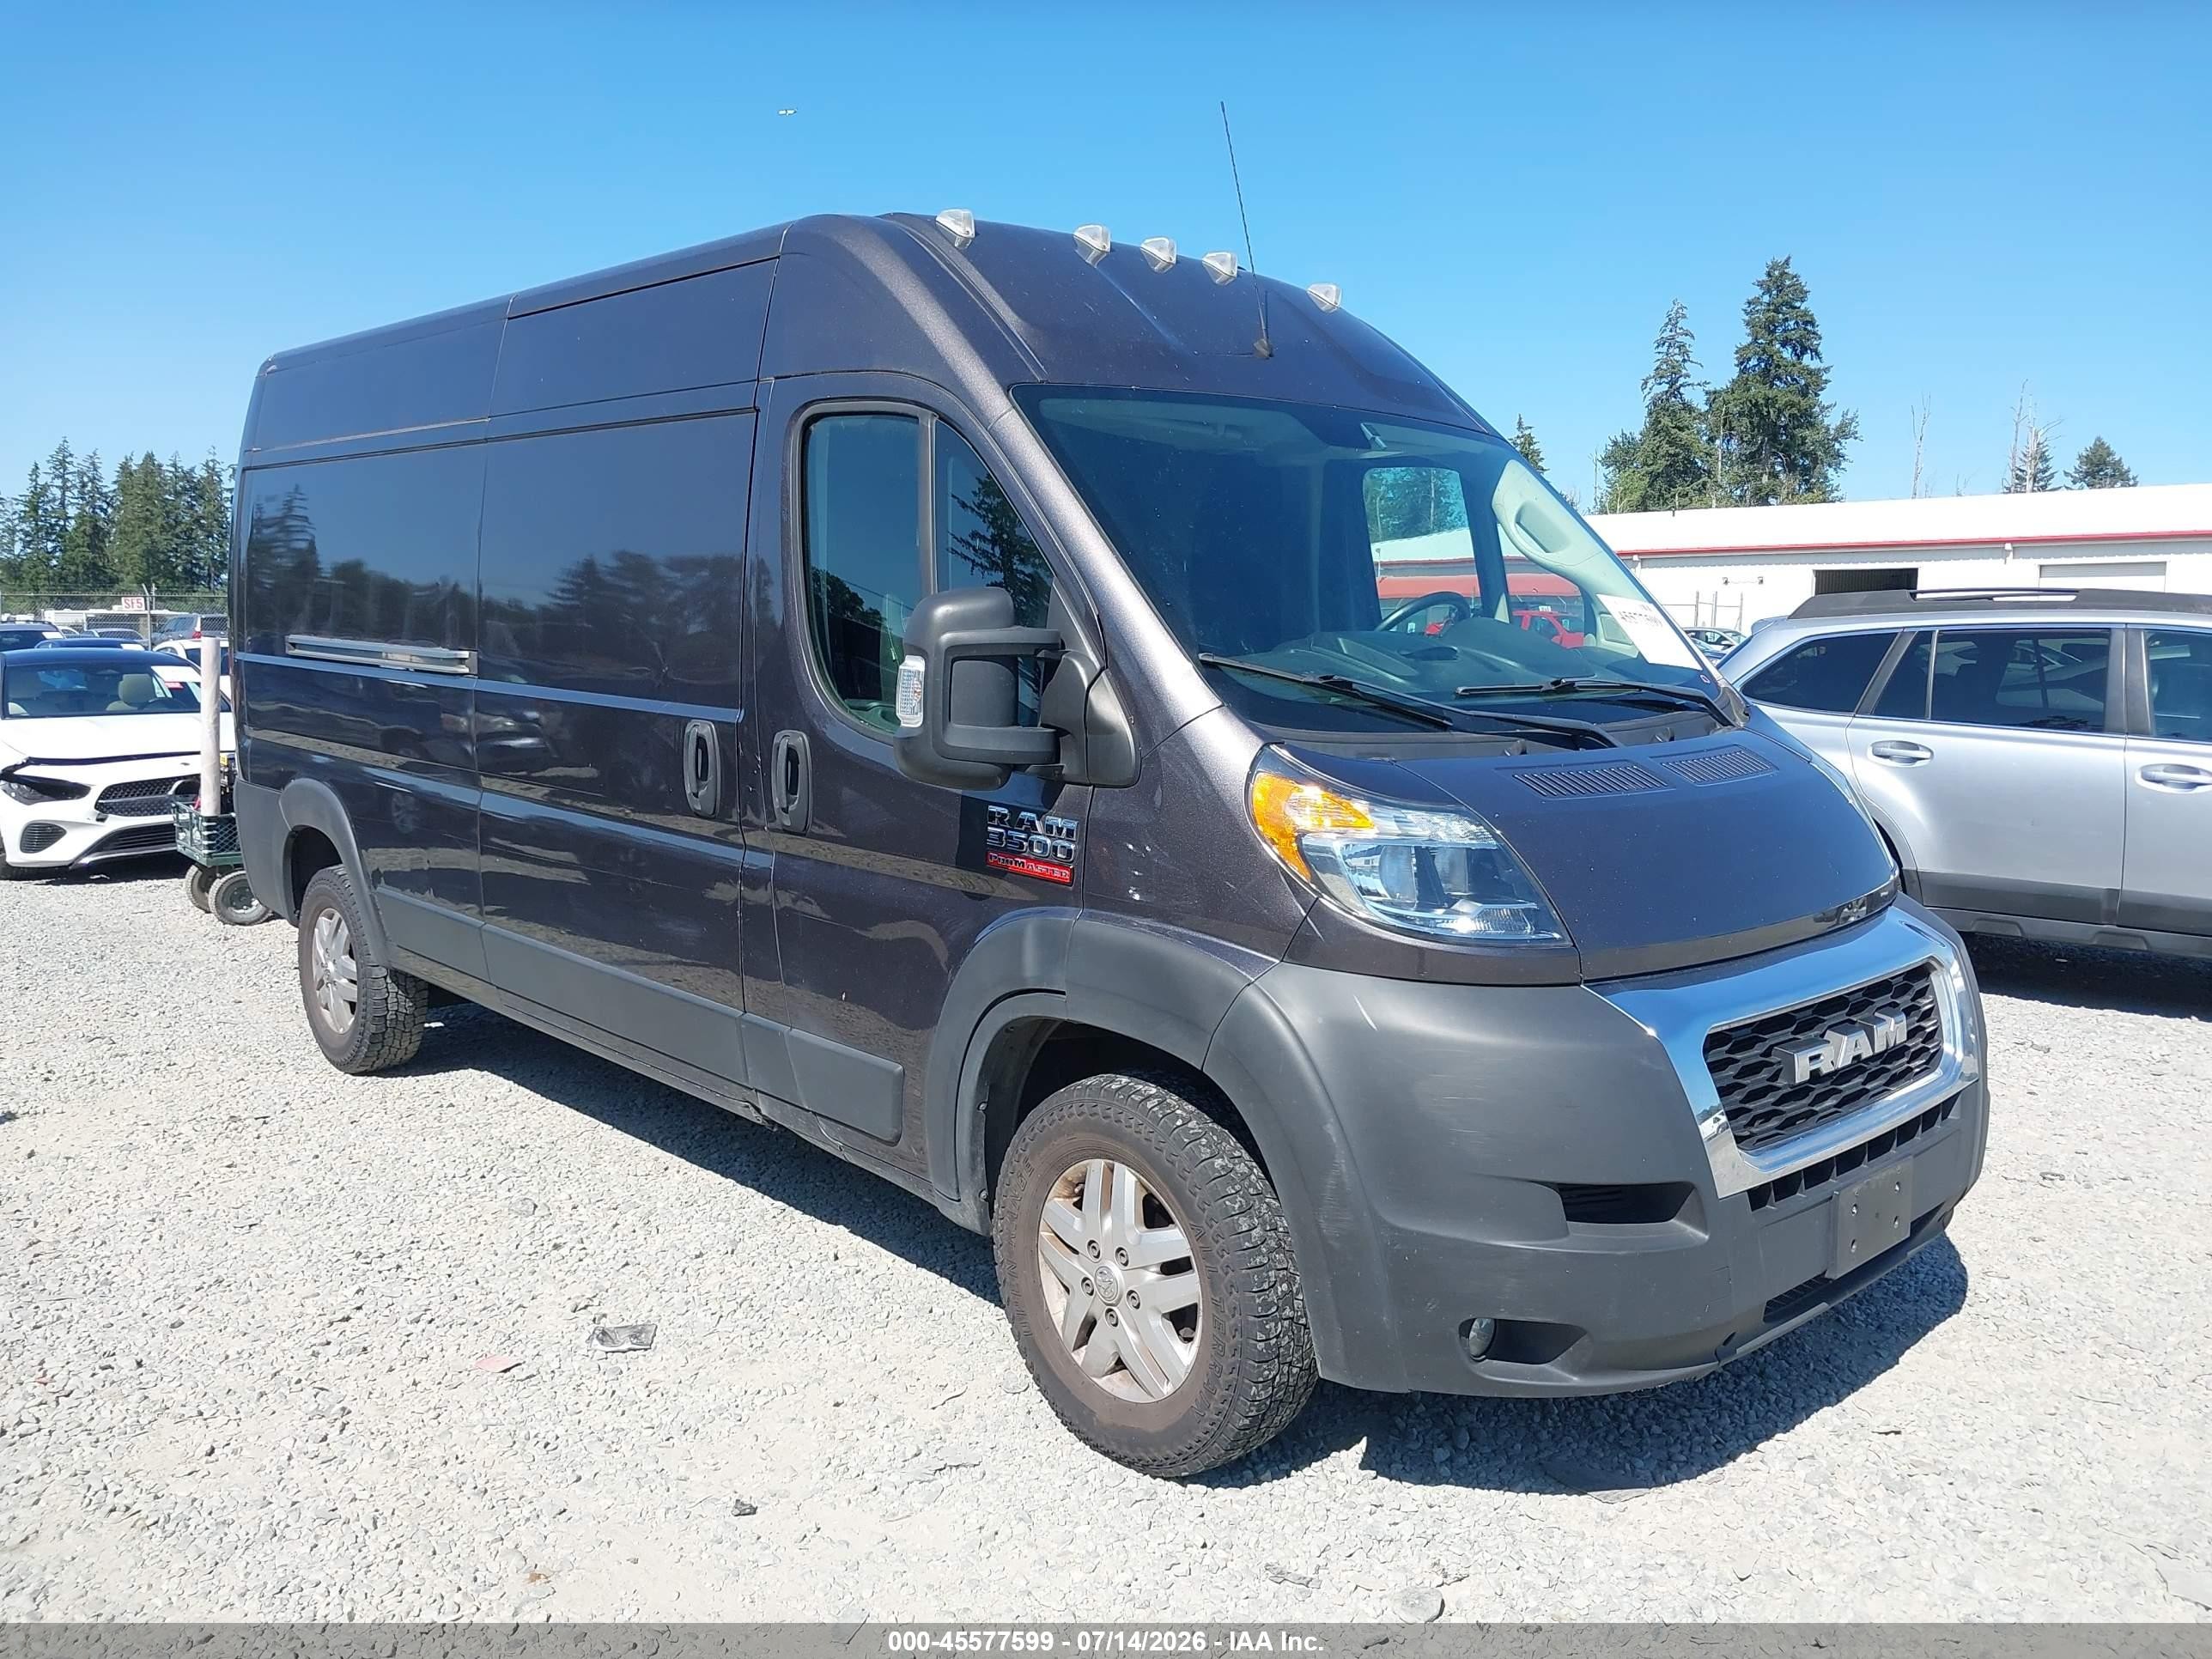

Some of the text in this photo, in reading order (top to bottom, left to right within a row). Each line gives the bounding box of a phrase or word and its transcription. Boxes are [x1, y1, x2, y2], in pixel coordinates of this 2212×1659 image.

[124, 599, 143, 609] SF5
[988, 805, 1079, 842] RAM
[987, 826, 1075, 862] 3500
[1774, 1008, 1907, 1084] RAM
[1190, 1222, 1226, 1424] ALL TERRAIN
